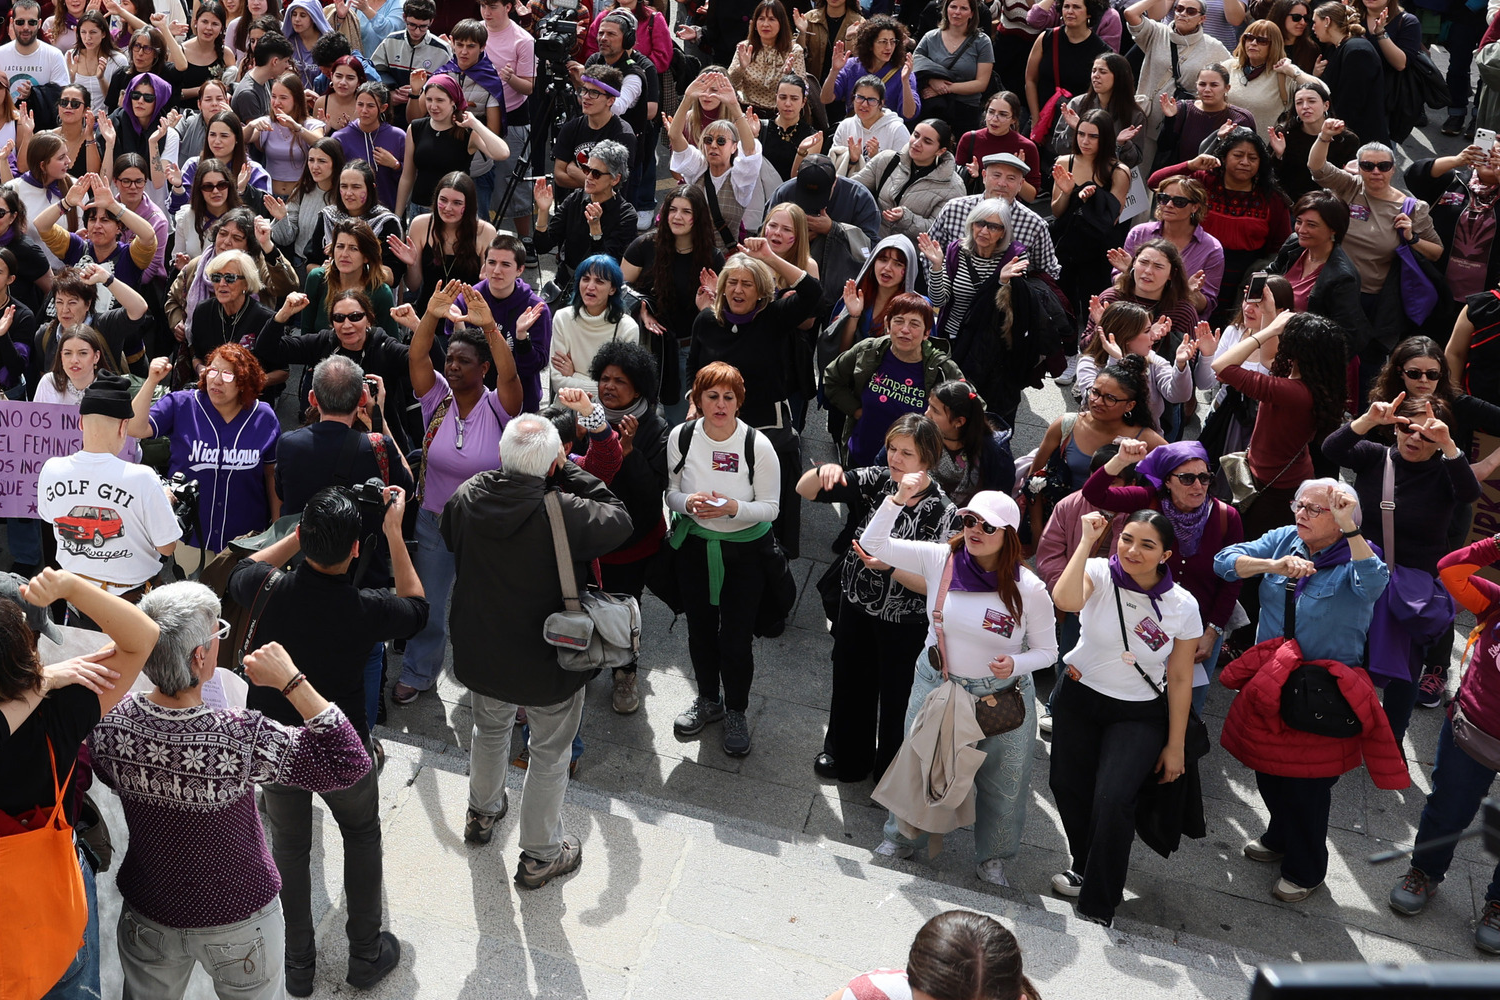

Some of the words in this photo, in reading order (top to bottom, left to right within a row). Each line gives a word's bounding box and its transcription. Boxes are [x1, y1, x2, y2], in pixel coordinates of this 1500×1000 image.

[29, 411, 52, 430] OS
[61, 413, 81, 431] INC
[23, 434, 83, 456] FEMINIS
[189, 439, 260, 469] Nicaragua
[20, 457, 43, 475] INC
[46, 480, 90, 502] GOLF
[97, 483, 135, 508] GTI
